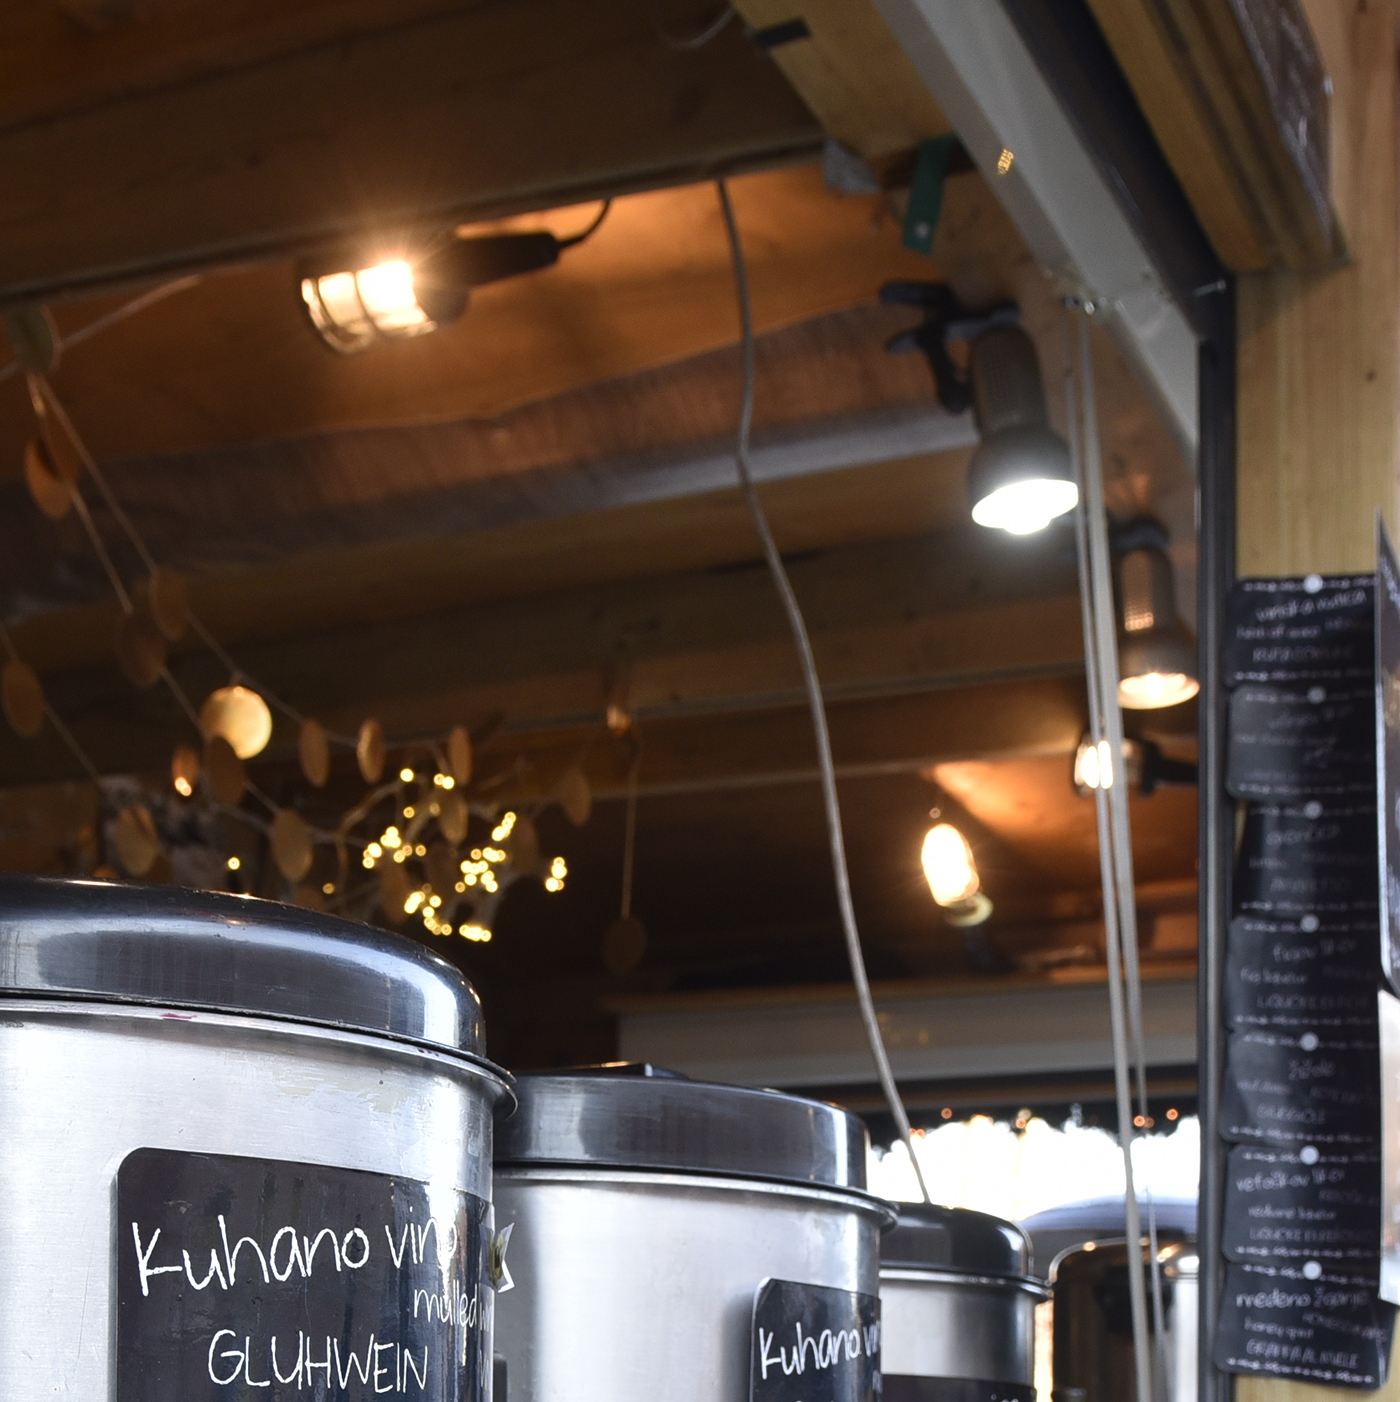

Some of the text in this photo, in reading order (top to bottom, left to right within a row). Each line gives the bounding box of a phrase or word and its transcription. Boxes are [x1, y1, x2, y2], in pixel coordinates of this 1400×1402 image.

[132, 1215, 369, 1296] Kuhano
[414, 1279, 477, 1328] mulled
[208, 1329, 428, 1393] GLUHWEIN
[759, 1321, 861, 1380] Kuhano
